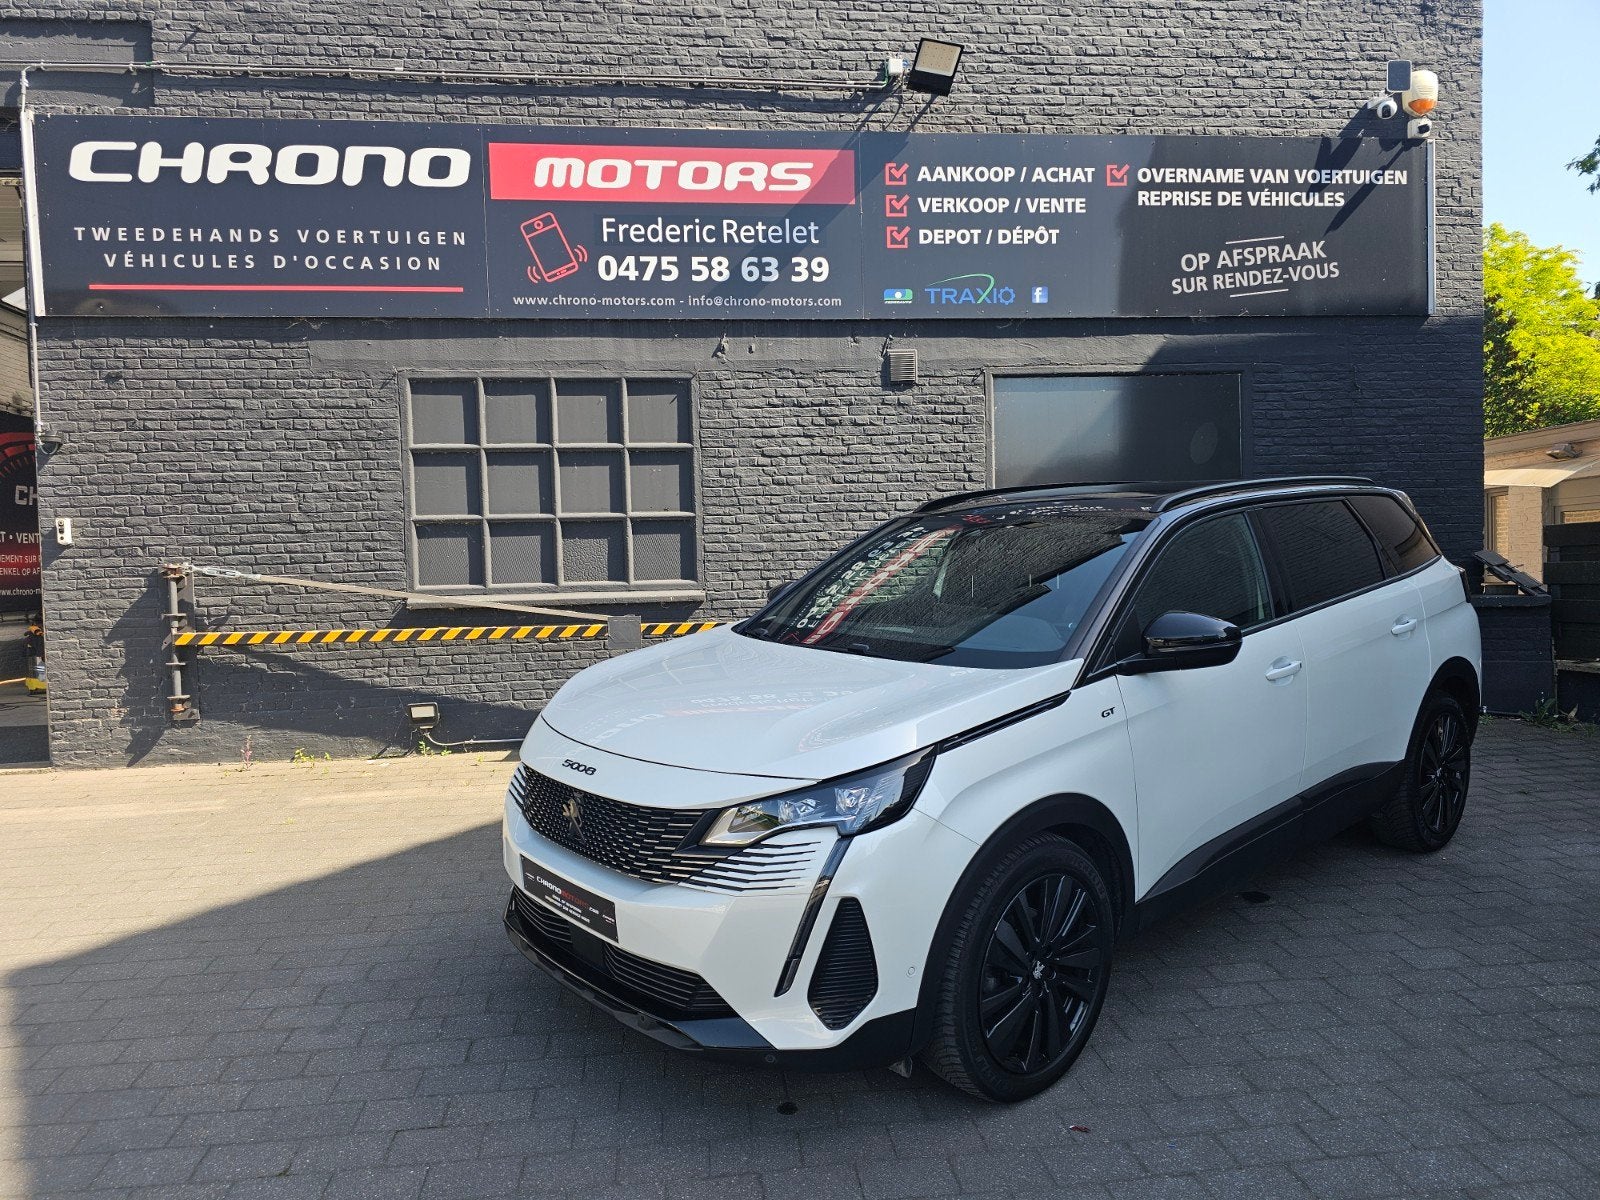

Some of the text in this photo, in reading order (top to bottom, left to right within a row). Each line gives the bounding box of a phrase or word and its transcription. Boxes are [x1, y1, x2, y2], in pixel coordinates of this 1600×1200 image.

[69, 141, 470, 187] CHRONO
[534, 157, 813, 192] MOTORS
[917, 166, 1095, 183] AANKOOP / ACHAT
[1137, 168, 1407, 185] OVERNAME VAN VOERTUIGEN
[917, 197, 1086, 213] VERKOOP / VENTE
[1137, 188, 1346, 207] REPRISE DE VÉHICULES
[74, 226, 467, 246] TWEEDEHANDS VOERTUIGEN
[602, 217, 819, 244] Frederic Retelet
[919, 226, 1060, 245] DEPOT / DÉPÔT
[104, 250, 441, 271] VÉHICULES D'OCCASION
[1180, 240, 1327, 272] OP AFSPRAAK
[598, 255, 829, 282] 0475 58 63 39
[1171, 262, 1340, 294] SUR RENDEZ-VOUS
[513, 294, 675, 307] www.chrono-motors.com
[688, 294, 842, 308] info@chrono-motors.com
[925, 286, 1016, 306] TRAXIO
[0, 554, 23, 563] EMENT
[1101, 706, 1115, 718] GT
[562, 758, 597, 776] 5008
